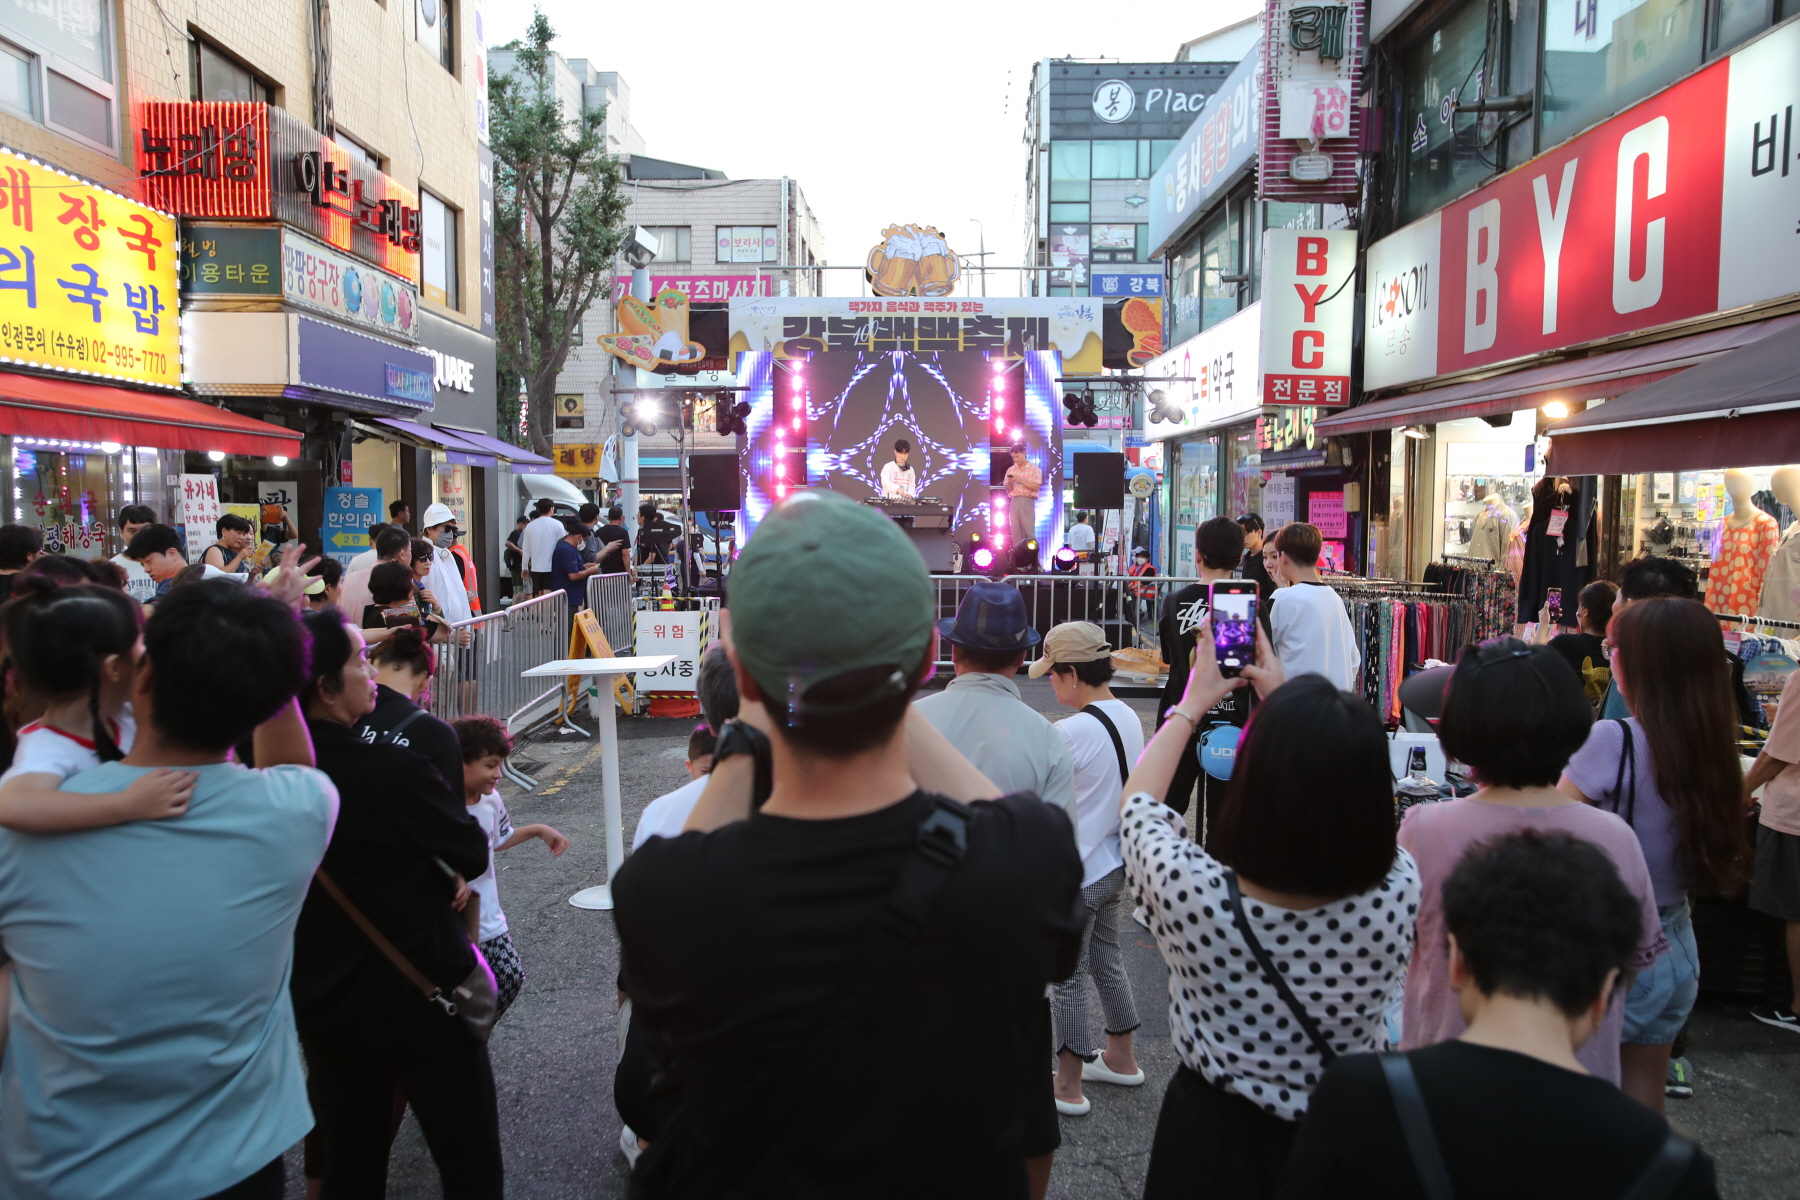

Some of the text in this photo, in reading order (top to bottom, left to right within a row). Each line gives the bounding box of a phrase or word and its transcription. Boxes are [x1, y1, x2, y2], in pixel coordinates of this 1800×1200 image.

[141, 124, 259, 183] 노래방
[733, 237, 762, 249] 보리사
[1464, 116, 1669, 354] BYC
[181, 263, 270, 284] 이용타운
[1129, 277, 1160, 293] 강북
[848, 301, 984, 312] 백가지 음식과 맥주가 있는
[1291, 237, 1329, 369] BYC
[50, 333, 90, 361] (수유점)
[92, 339, 166, 375] 02-995-7770
[416, 346, 474, 393] QUARE
[1272, 378, 1342, 402] 전문점
[184, 479, 215, 500] 유가네
[337, 492, 369, 509] 청솔
[328, 512, 377, 529] 한의원
[39, 521, 106, 552] 평해장국
